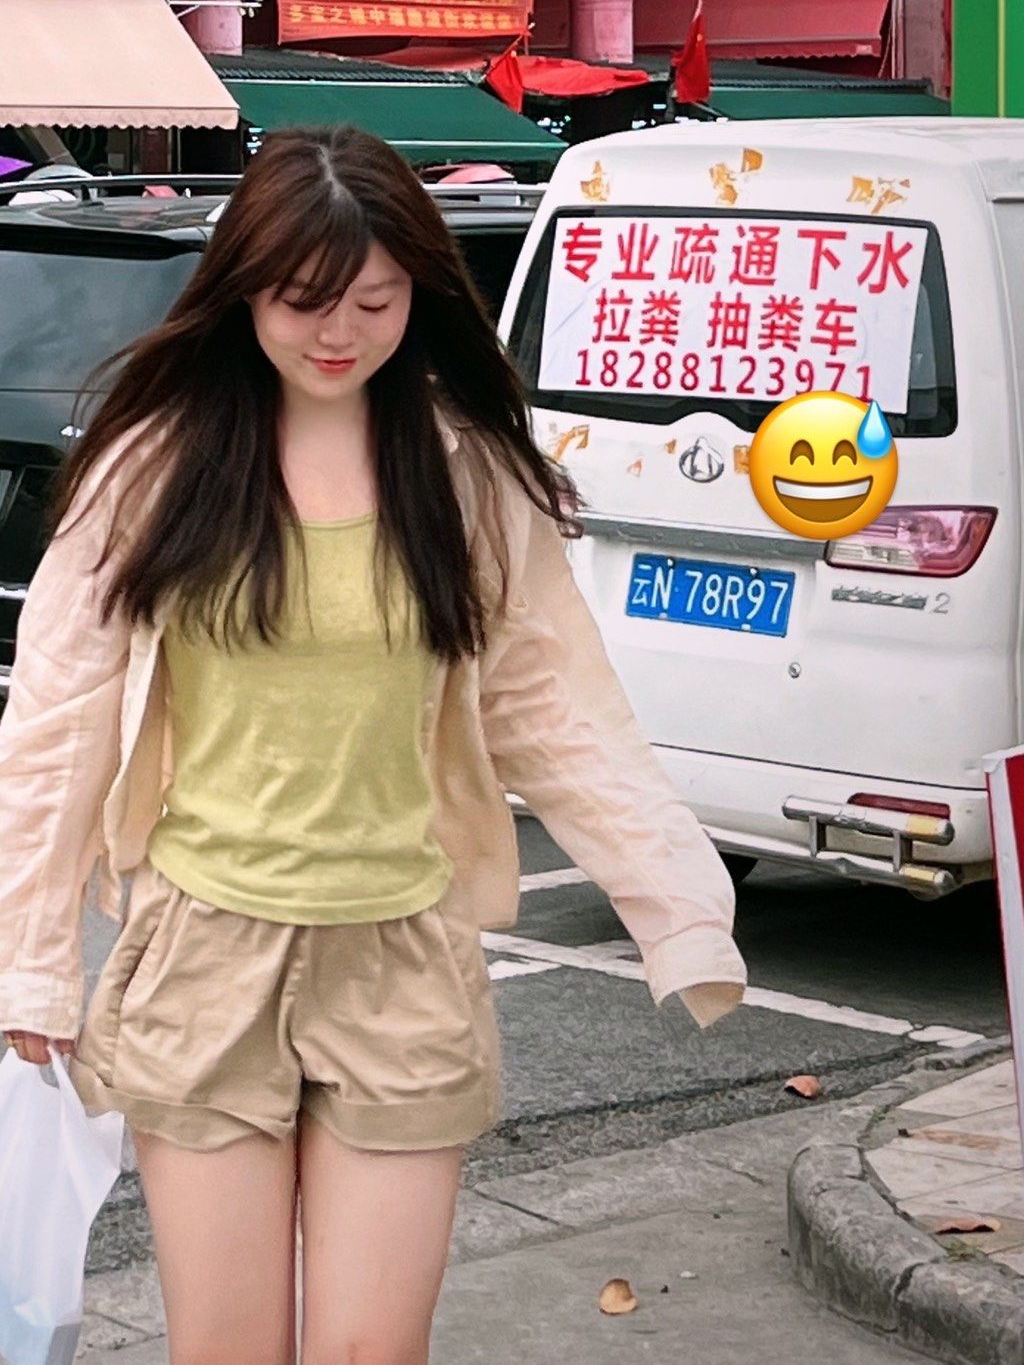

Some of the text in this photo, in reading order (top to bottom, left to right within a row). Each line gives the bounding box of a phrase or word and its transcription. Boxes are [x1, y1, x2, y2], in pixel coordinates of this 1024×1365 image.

[561, 221, 914, 295] 专业疏通下水
[591, 287, 858, 356] 拉粪 抽粪车
[575, 348, 875, 404] 18288123971
